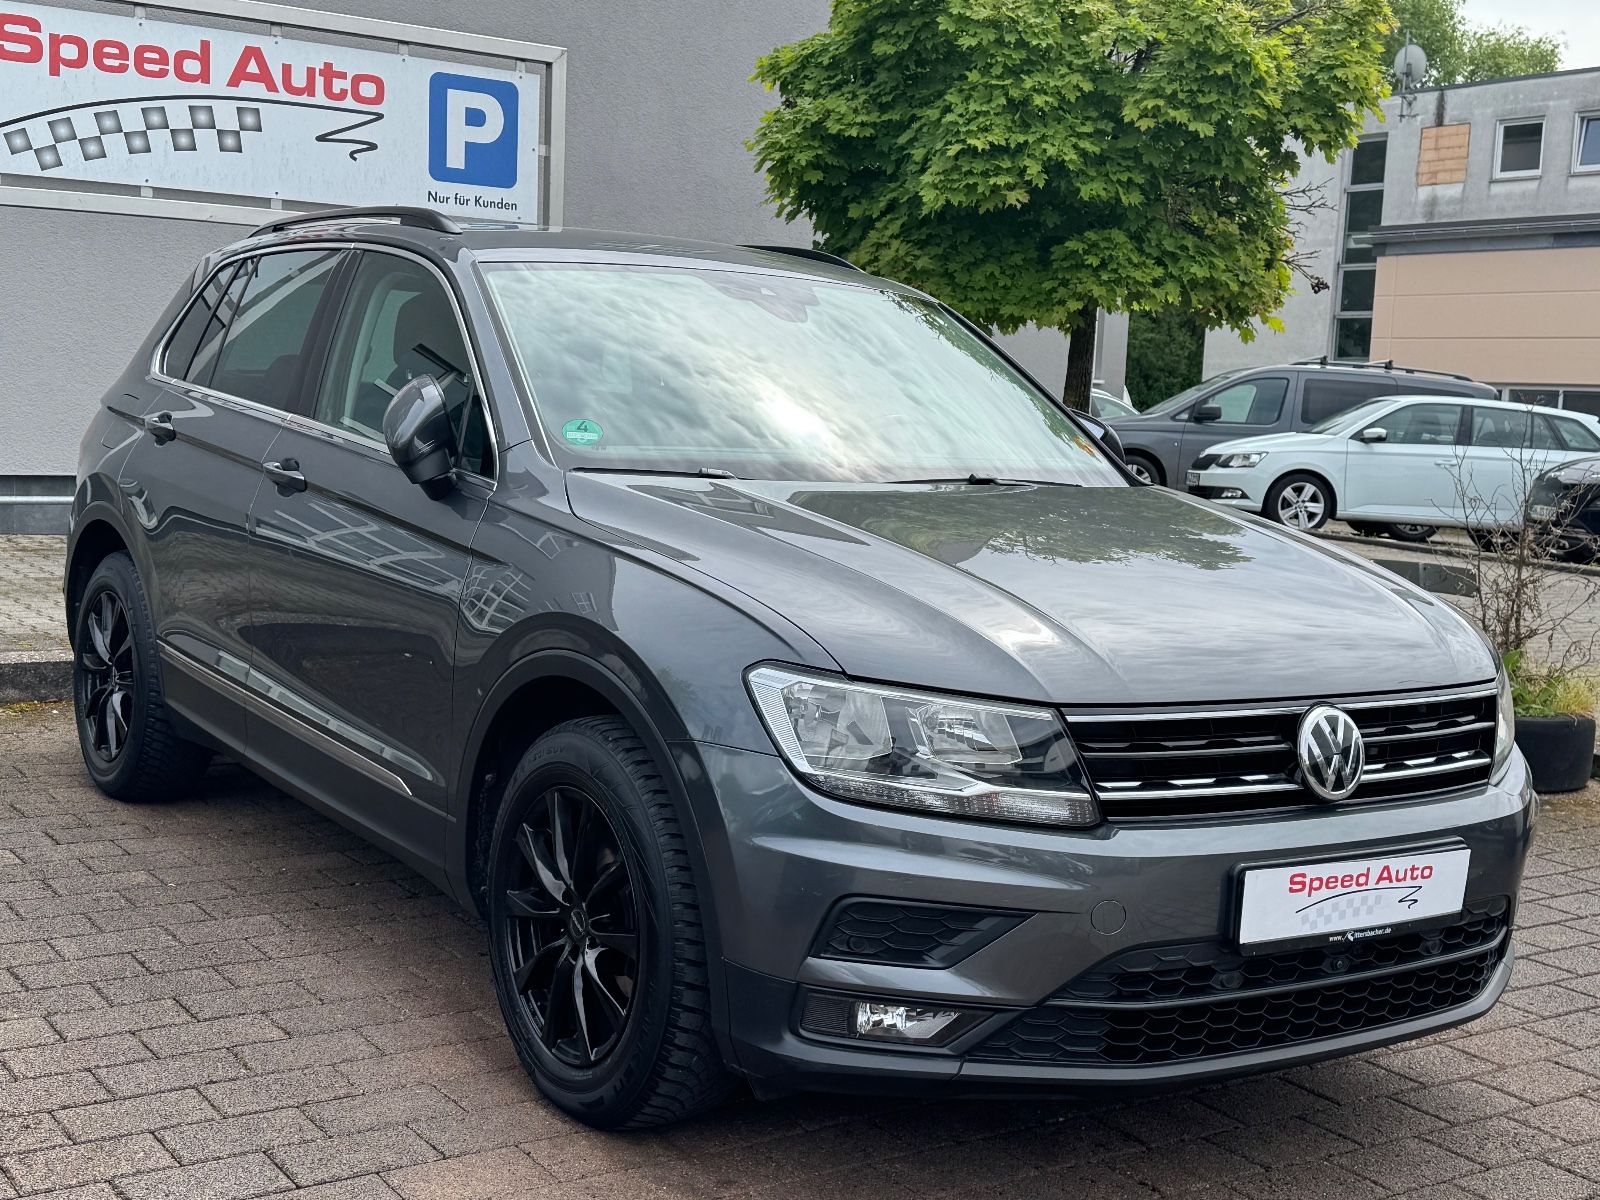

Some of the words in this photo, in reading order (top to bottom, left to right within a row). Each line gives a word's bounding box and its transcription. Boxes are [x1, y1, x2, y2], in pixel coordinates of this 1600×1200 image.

[0, 12, 211, 85] Speed
[226, 45, 385, 106] Auto
[446, 88, 505, 170] P
[427, 190, 451, 204] Nur
[454, 193, 471, 207] für
[474, 195, 518, 211] Kunden
[577, 420, 589, 433] 4
[1288, 867, 1371, 897] Speed
[1375, 864, 1433, 886] Auto
